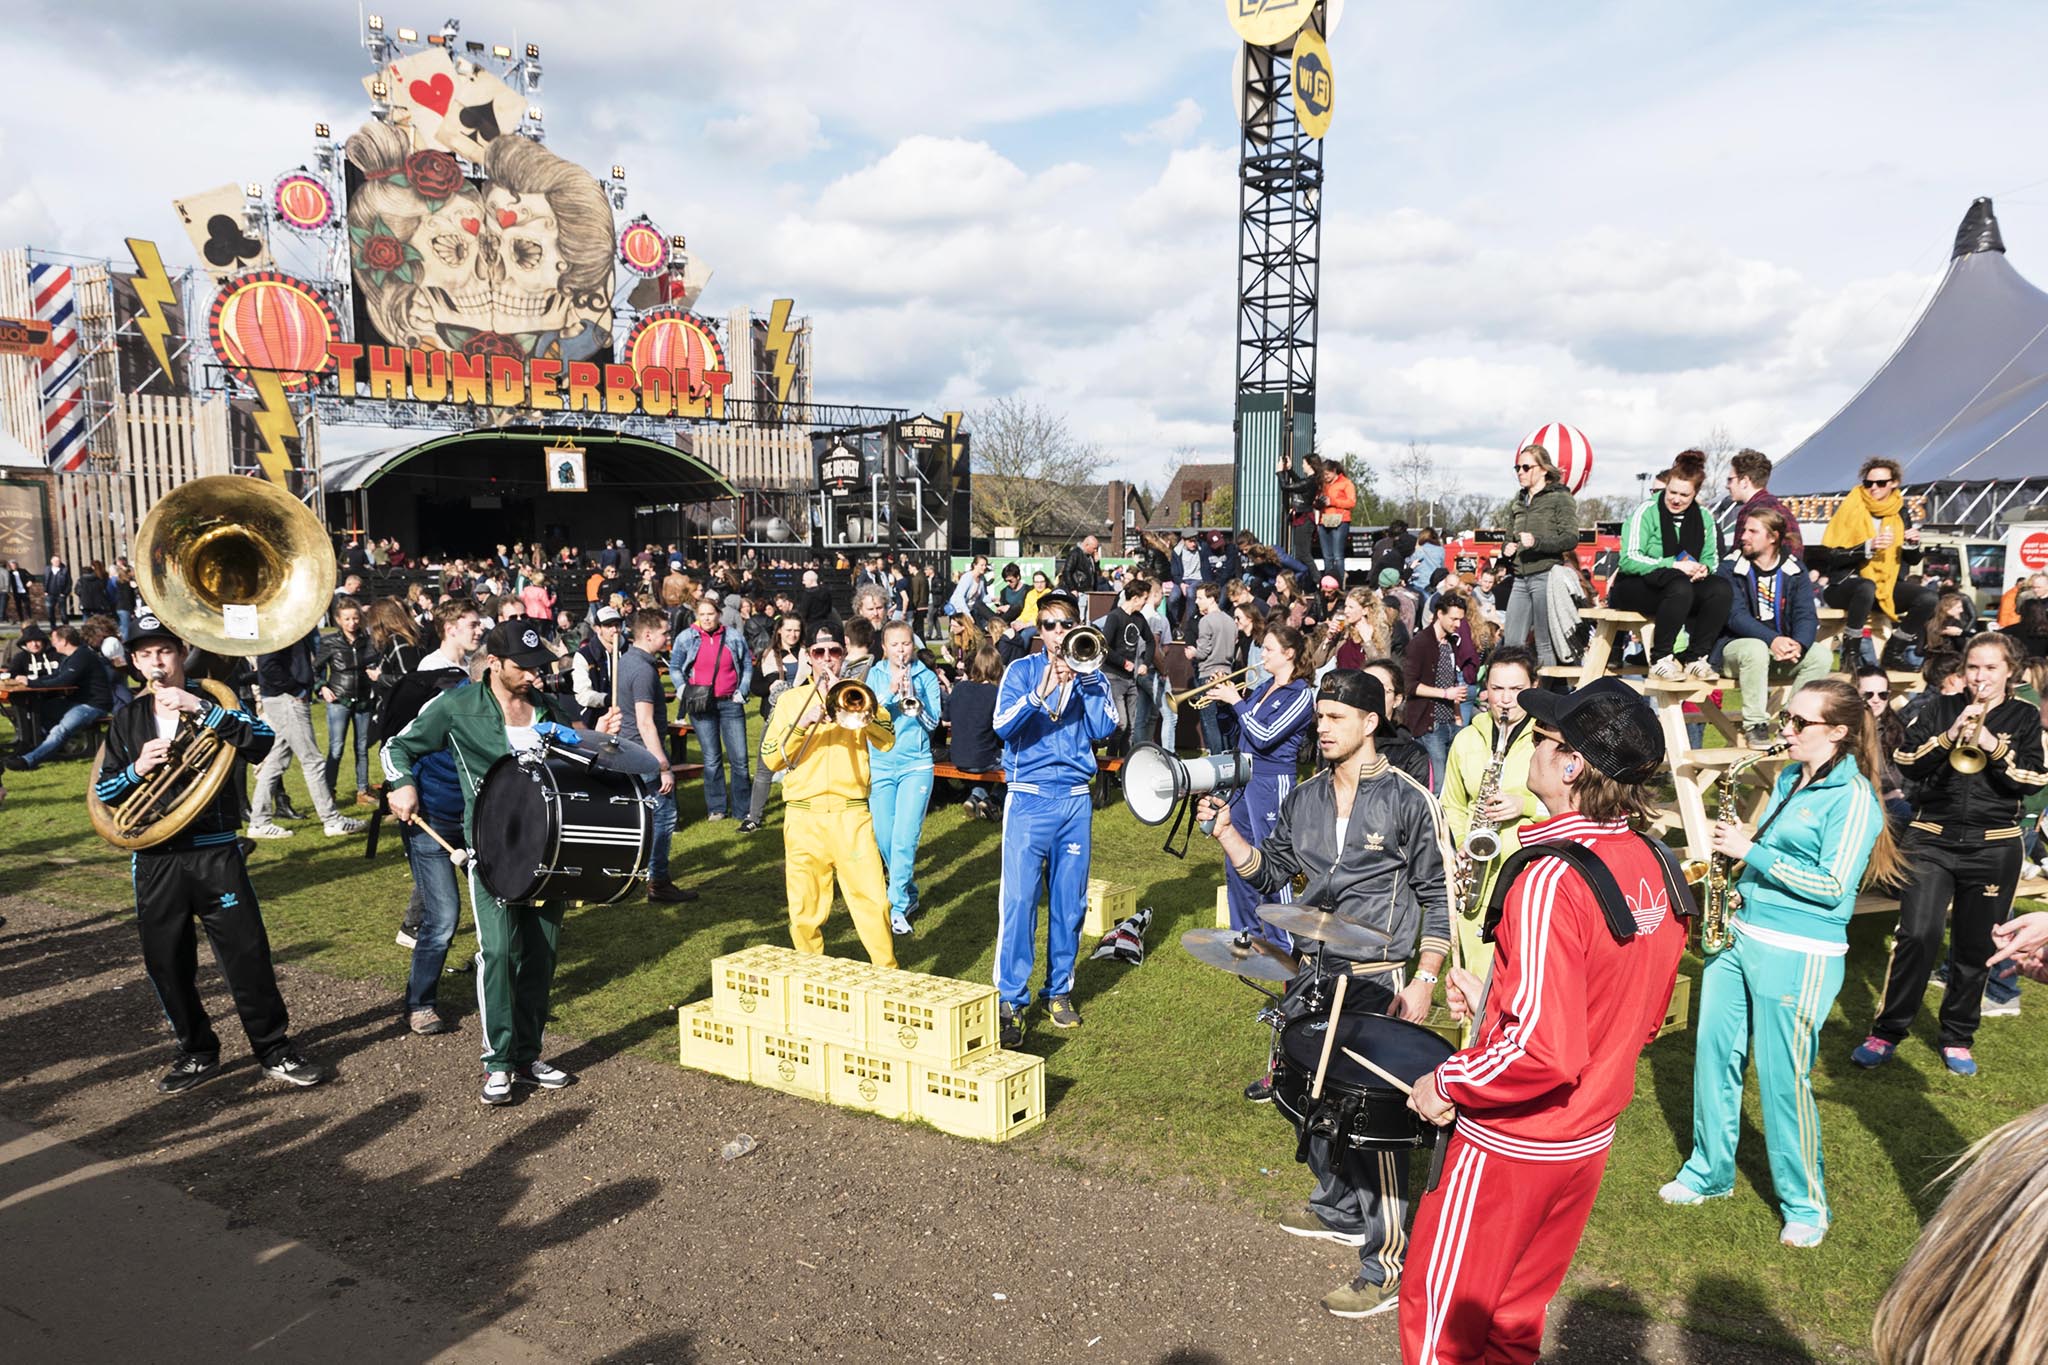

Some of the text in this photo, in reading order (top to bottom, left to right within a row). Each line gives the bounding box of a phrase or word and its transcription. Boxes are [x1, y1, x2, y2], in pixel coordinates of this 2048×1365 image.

[327, 342, 733, 421] THUNDERBOLT
[901, 426, 945, 440] THE BREWERY
[833, 459, 860, 479] BREWERY
